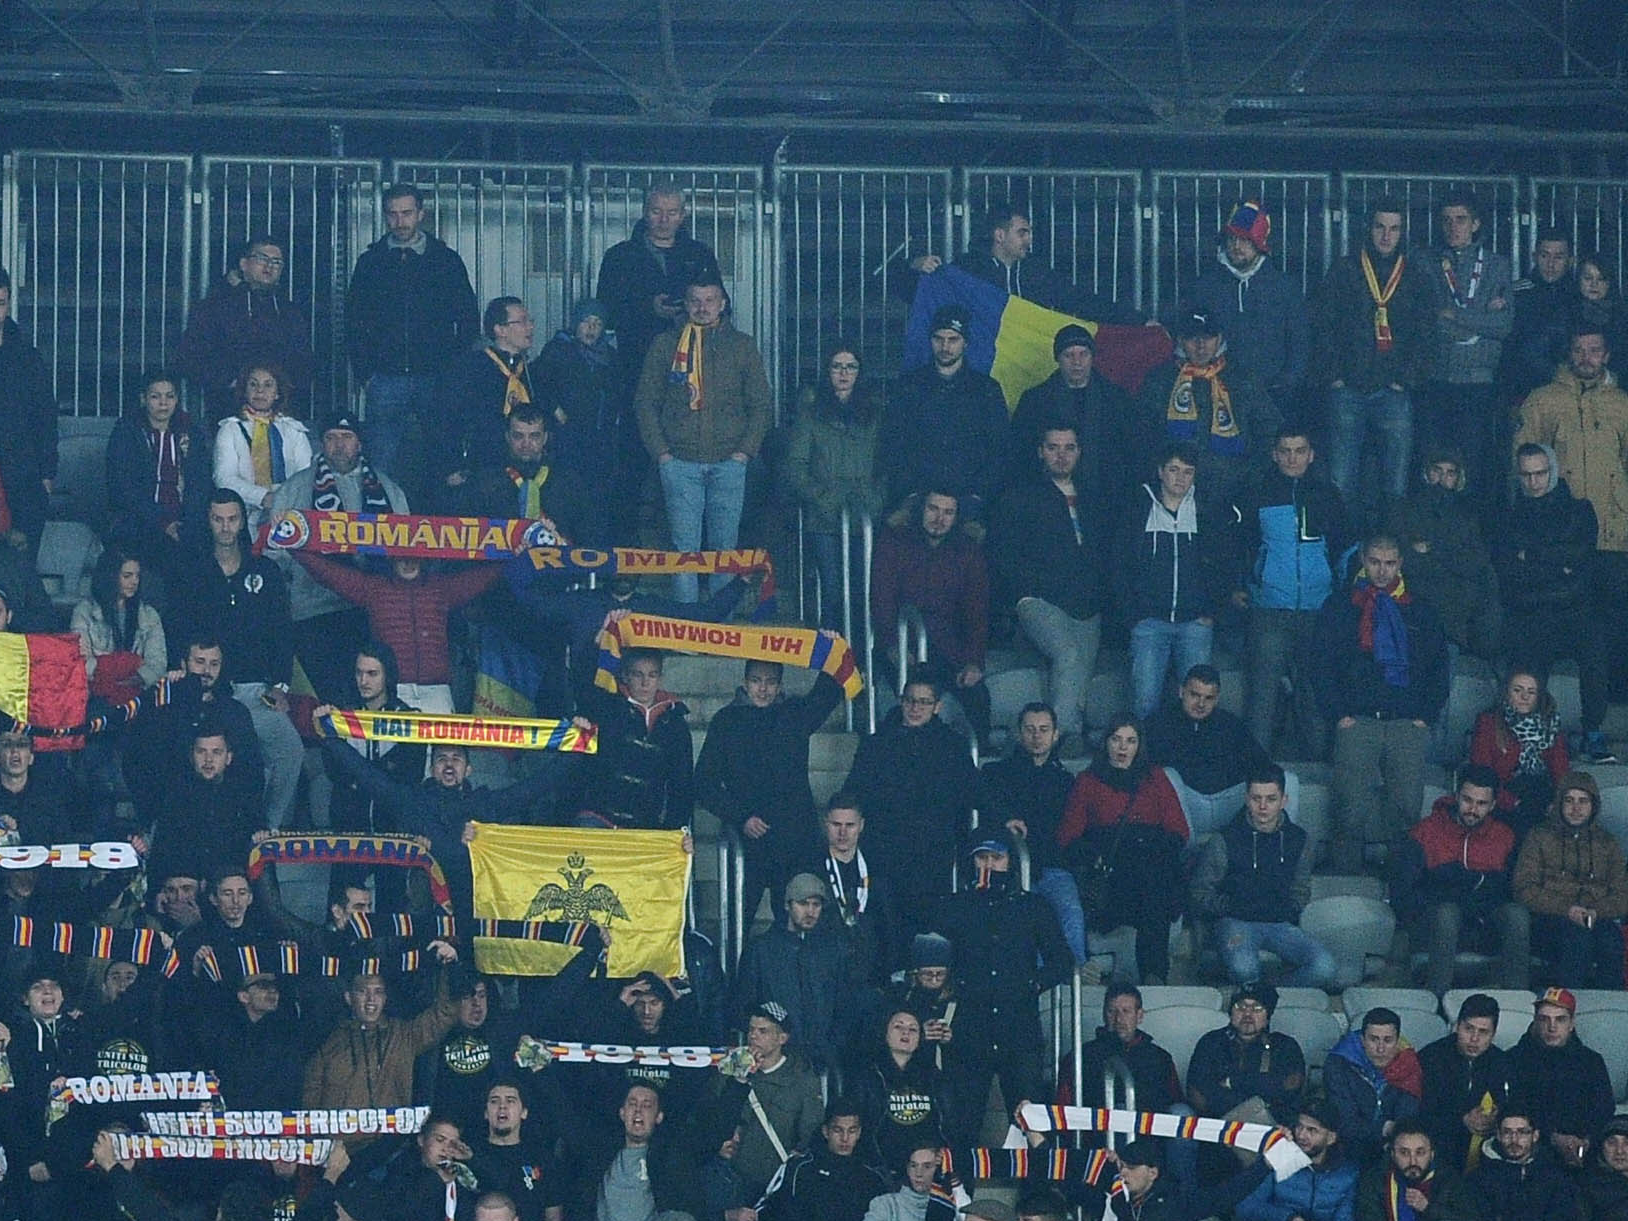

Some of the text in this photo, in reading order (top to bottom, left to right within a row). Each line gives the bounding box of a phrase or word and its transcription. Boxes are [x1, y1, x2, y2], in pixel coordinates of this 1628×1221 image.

[630, 618, 804, 655] HAI ROMANIA
[372, 716, 412, 738] HAI
[417, 718, 525, 745] ROMÂNIA
[558, 1042, 713, 1068] 1918
[66, 1071, 212, 1104] ROMANIA
[224, 1110, 283, 1135] SUB
